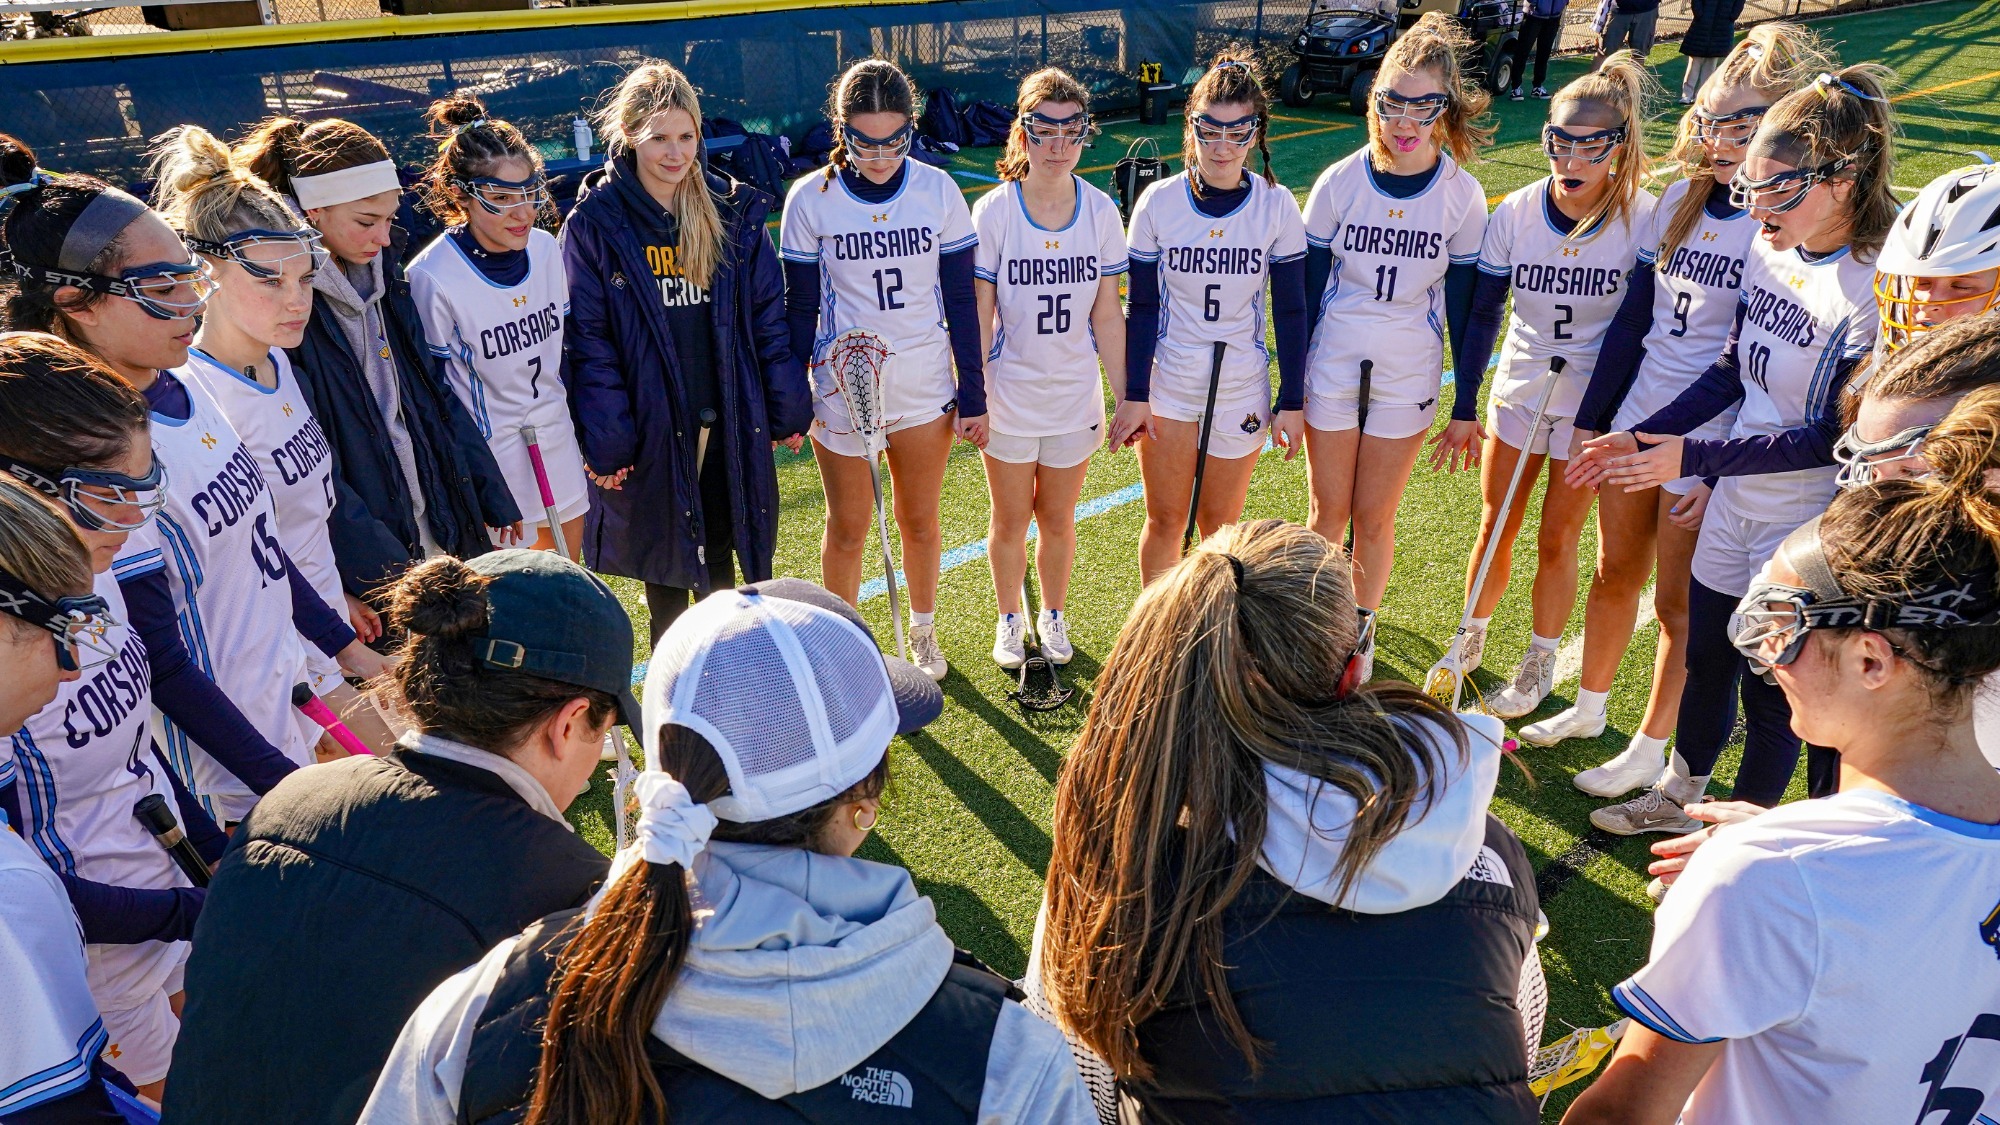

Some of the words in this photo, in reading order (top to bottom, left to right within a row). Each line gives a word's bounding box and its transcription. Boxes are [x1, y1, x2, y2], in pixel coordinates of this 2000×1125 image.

[1139, 169, 1155, 177] STX
[833, 226, 933, 261] CORSAIRS
[1344, 223, 1443, 260] CORSAIRS
[1008, 255, 1098, 286] CORSAIRS
[1168, 246, 1263, 275] CORSAIRS
[45, 270, 94, 290] STX
[872, 267, 905, 311] 12
[1373, 264, 1398, 302] 11
[1515, 263, 1621, 297] CORSAIRS
[1037, 293, 1072, 335] 26
[1203, 283, 1222, 322] 6
[1668, 291, 1692, 338] 9
[480, 301, 561, 361] CORSAIRS
[1554, 303, 1573, 340] 2
[527, 355, 542, 400] 7
[1748, 341, 1771, 395] 10
[840, 1073, 891, 1094] NORTH
[865, 1066, 893, 1083] THE
[851, 1088, 889, 1106] FACE
